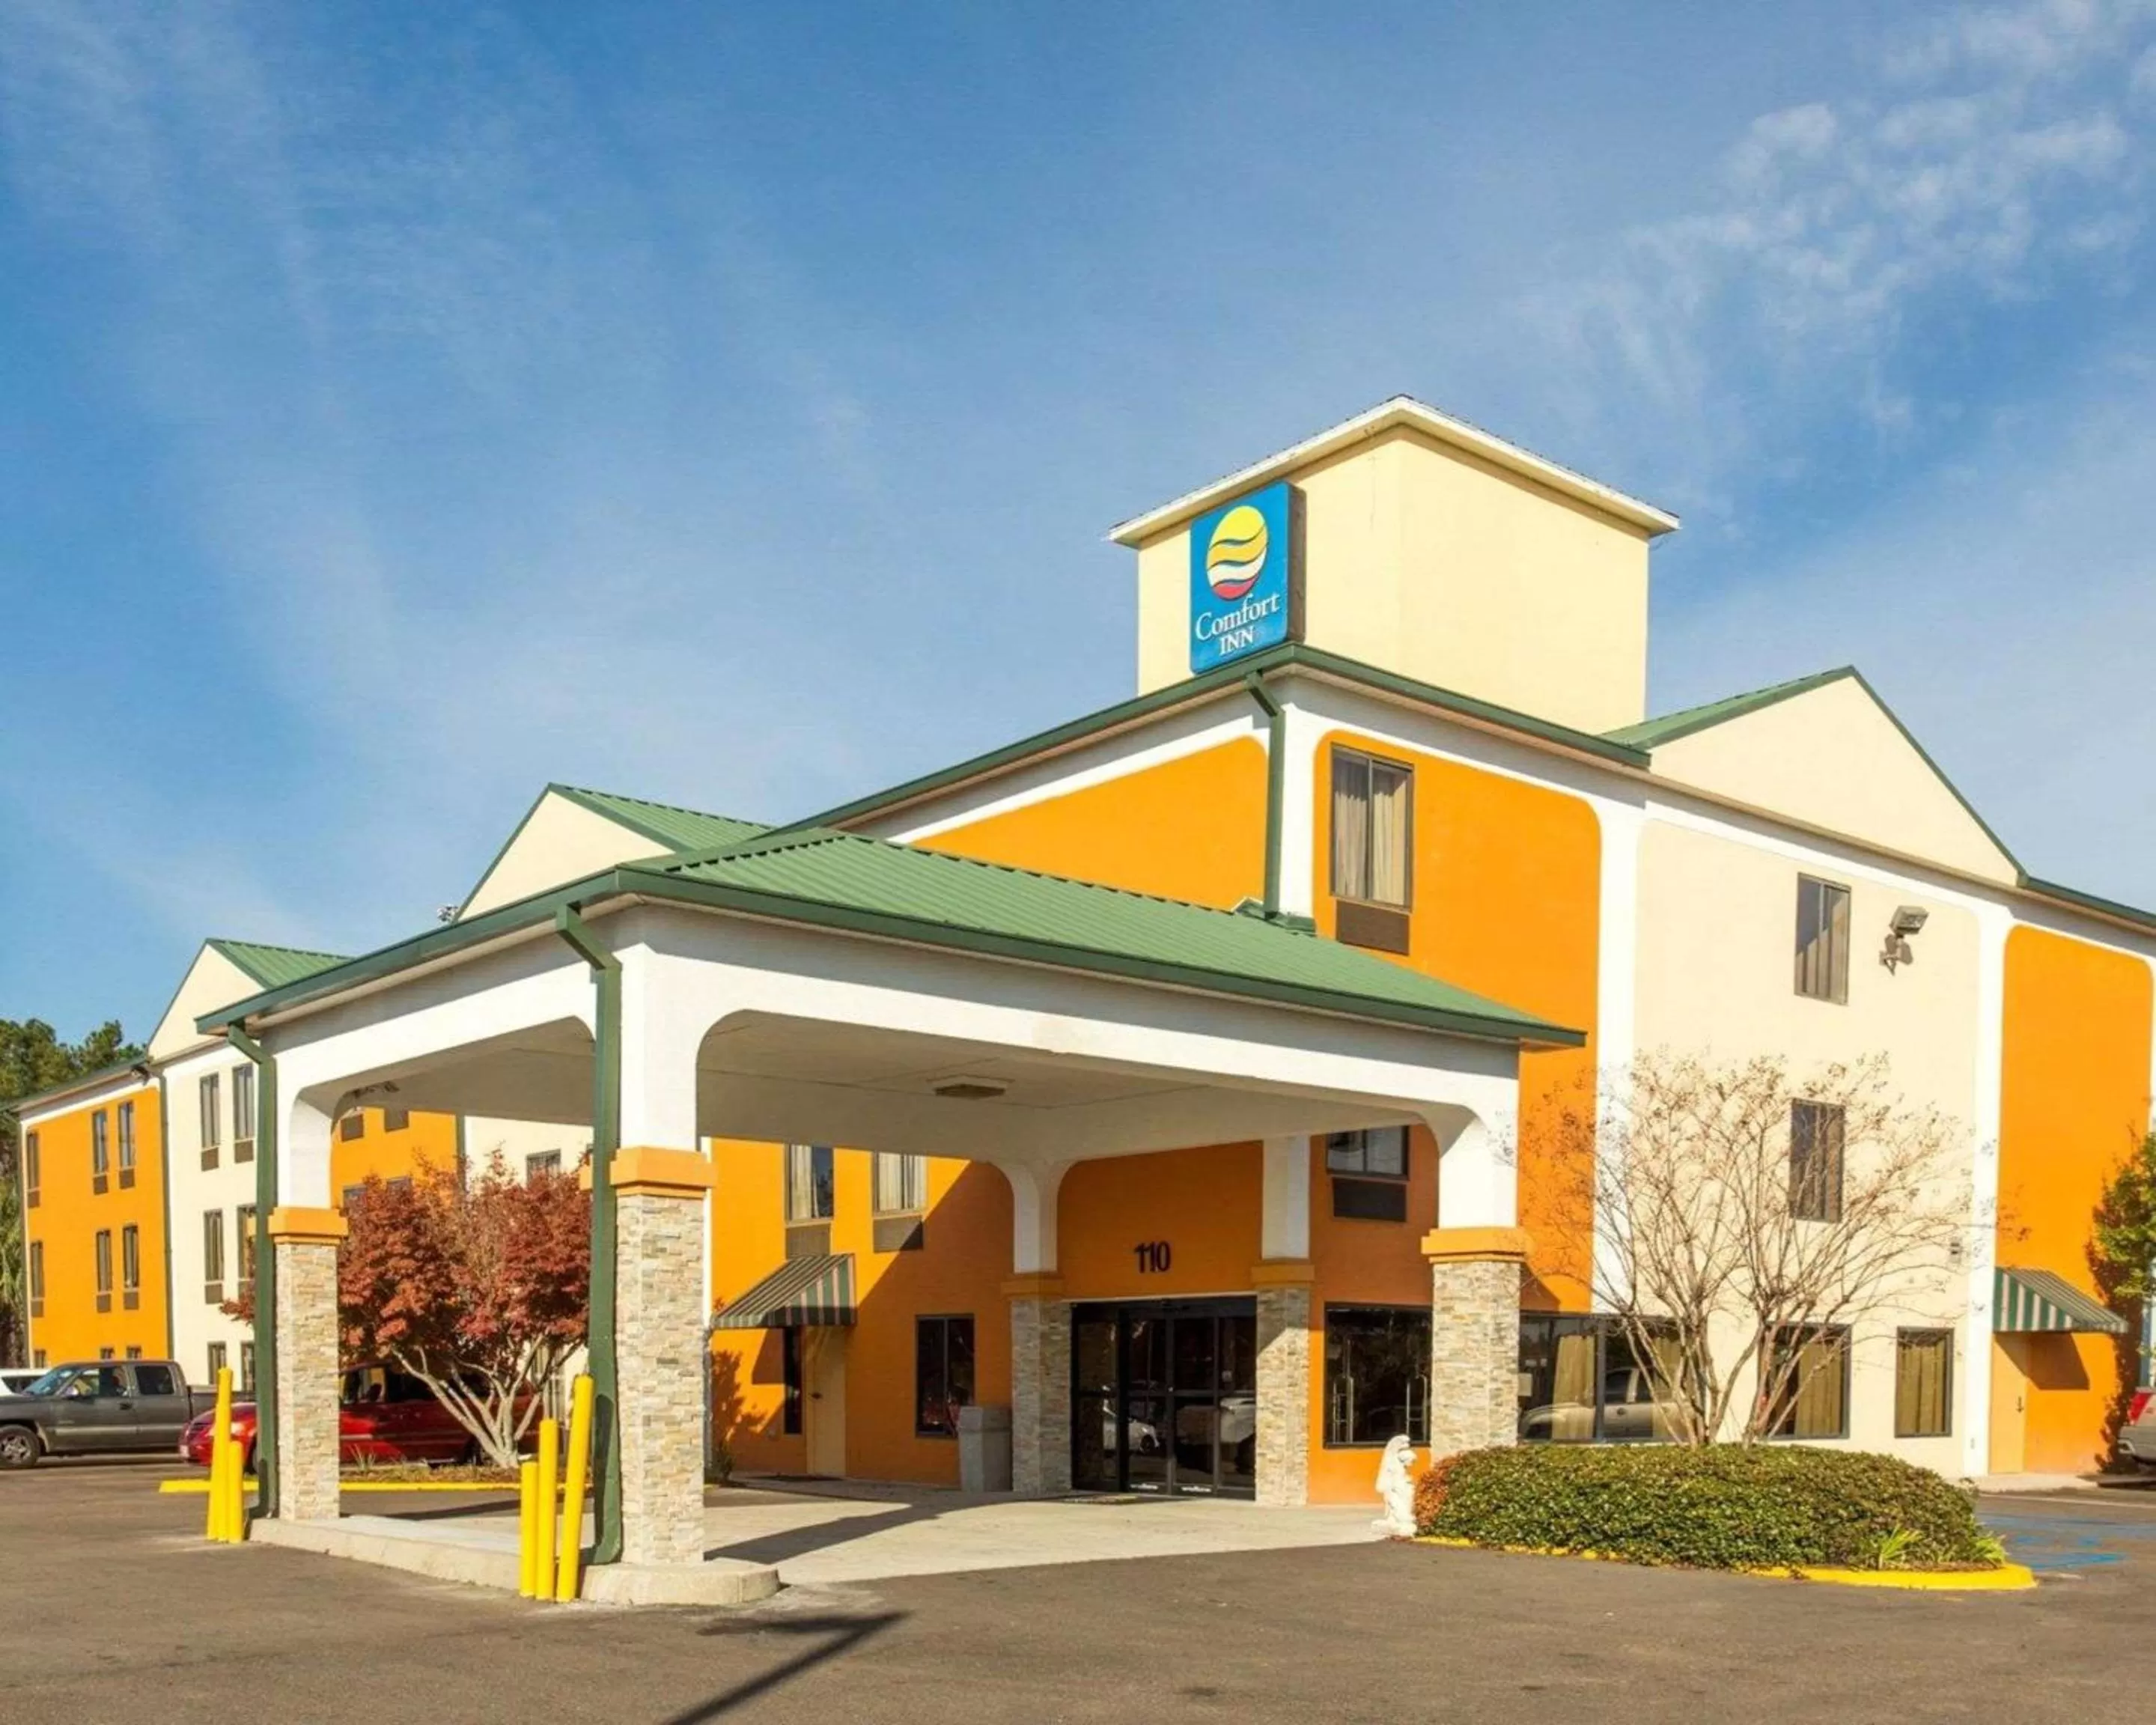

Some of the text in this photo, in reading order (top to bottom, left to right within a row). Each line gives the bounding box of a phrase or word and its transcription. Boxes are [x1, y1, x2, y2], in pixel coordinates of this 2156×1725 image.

[1196, 592, 1280, 641] Comfort
[1219, 625, 1255, 657] INN
[1133, 1240, 1172, 1274] 110
